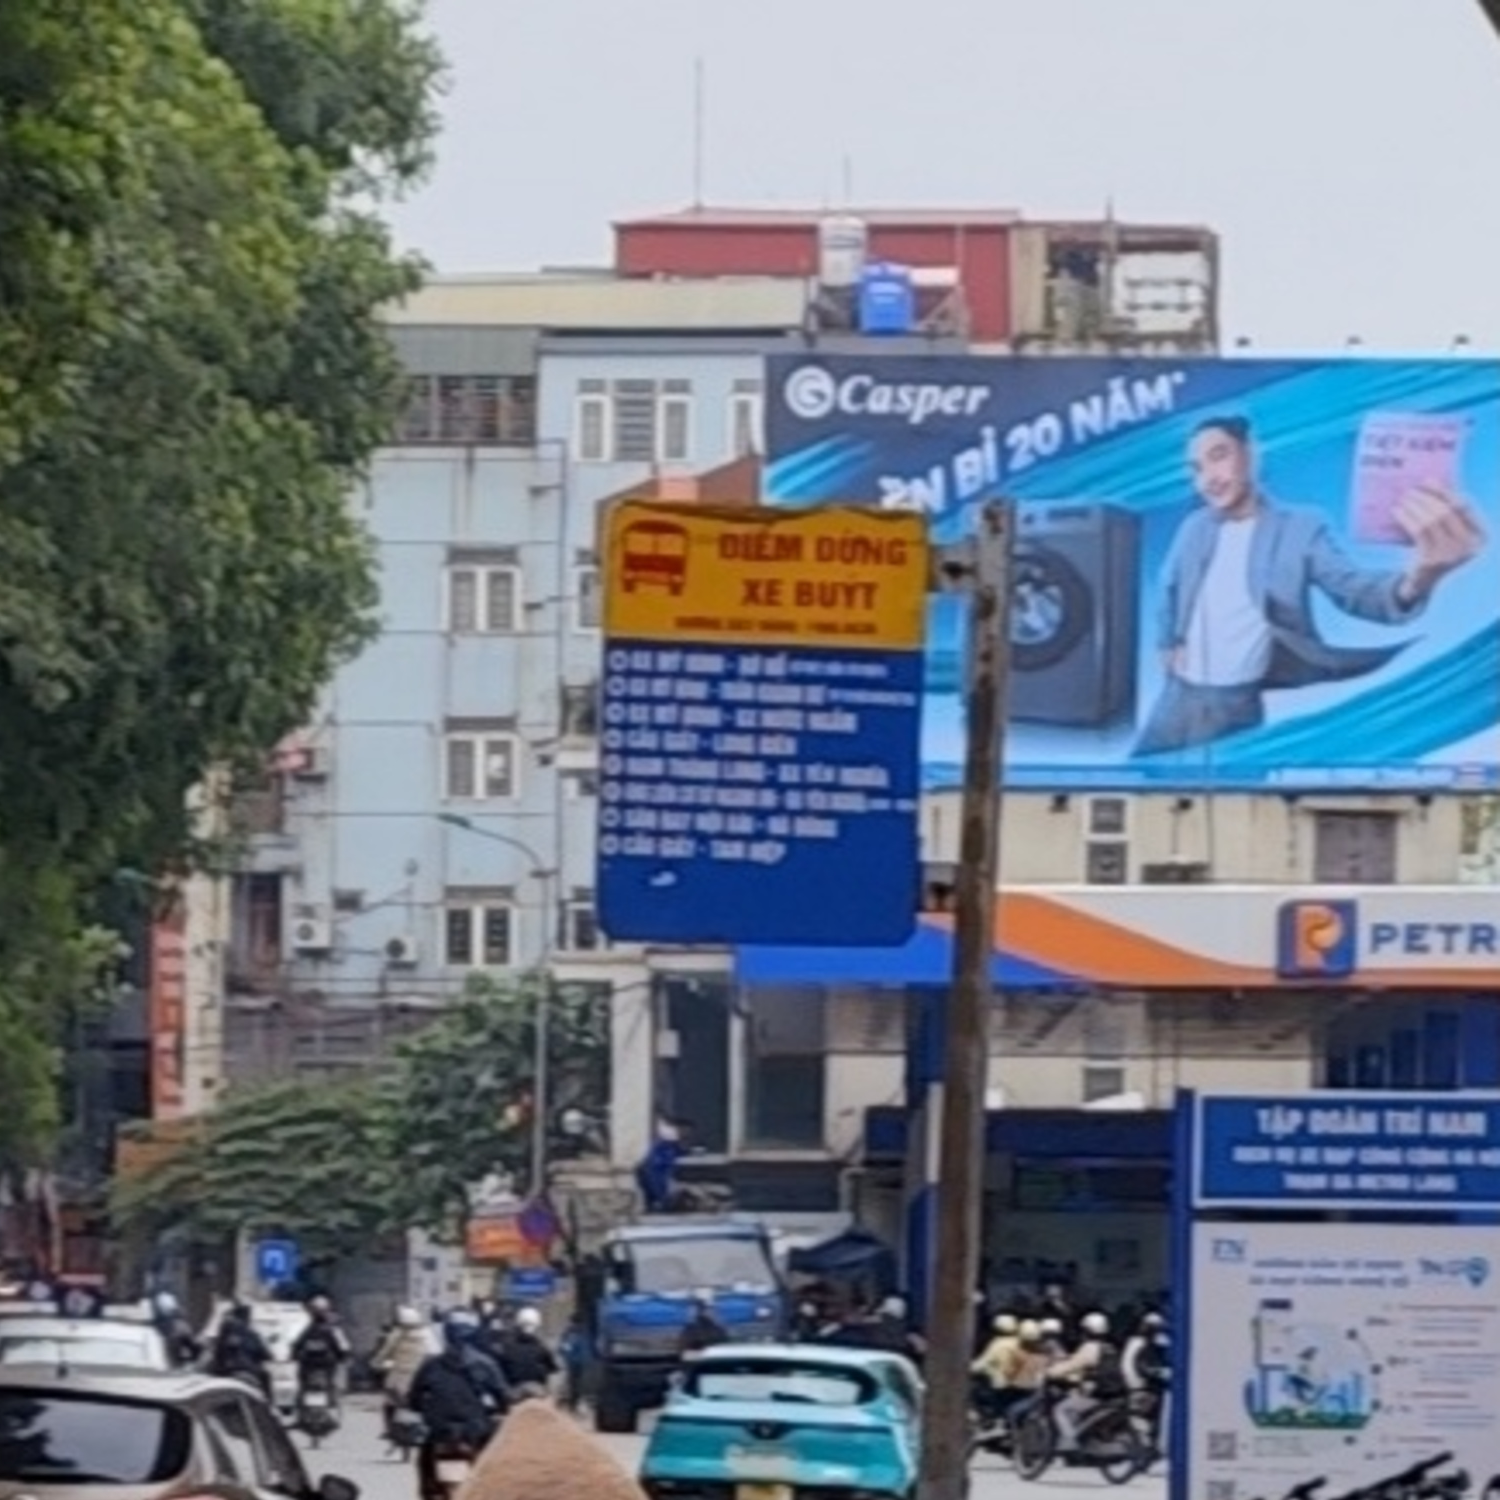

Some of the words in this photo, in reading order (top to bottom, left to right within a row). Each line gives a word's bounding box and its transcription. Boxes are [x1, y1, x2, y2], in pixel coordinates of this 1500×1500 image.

[838, 374, 990, 424] Casper
[1005, 413, 1063, 471] 20
[741, 578, 783, 607] XE
[795, 572, 878, 610] BUÝT
[1370, 922, 1497, 954] PETR
